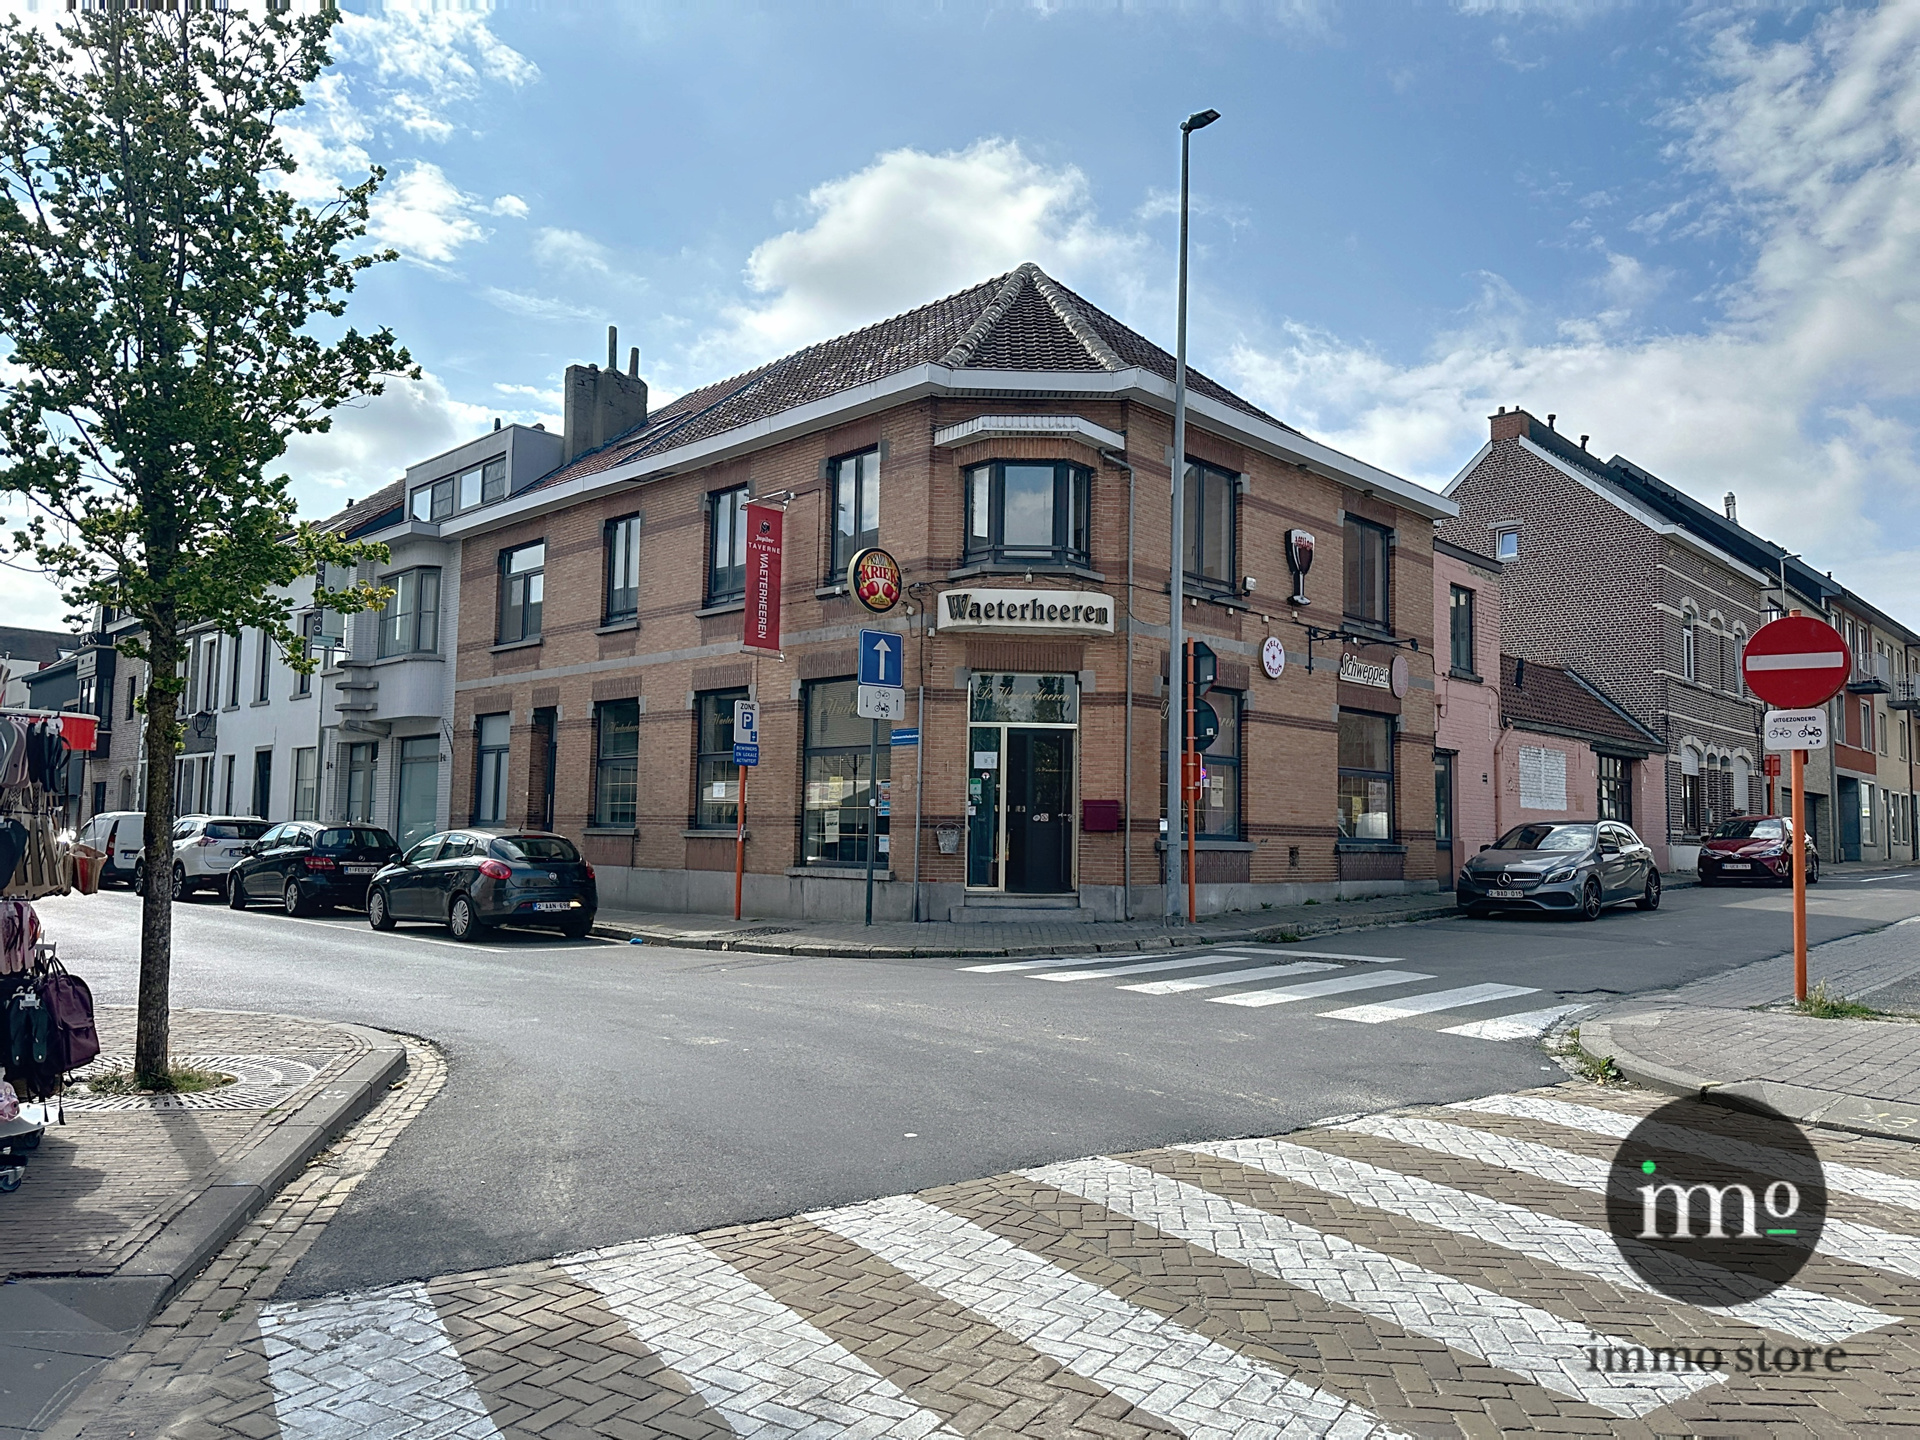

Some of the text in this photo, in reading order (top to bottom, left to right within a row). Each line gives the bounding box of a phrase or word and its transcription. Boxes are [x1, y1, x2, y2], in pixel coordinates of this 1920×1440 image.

[755, 534, 775, 543] Jupiler
[748, 541, 781, 554] TAVERNE
[861, 564, 898, 586] KRIEK
[757, 553, 769, 639] WAETERHEEREN
[946, 593, 1109, 625] Waeterheeren
[1265, 640, 1283, 654] STELLA
[1265, 661, 1282, 675] ARTOIS
[1341, 653, 1389, 685] Schweppes
[740, 702, 756, 711] ZONE
[1773, 715, 1817, 723] UITGEZONDERD
